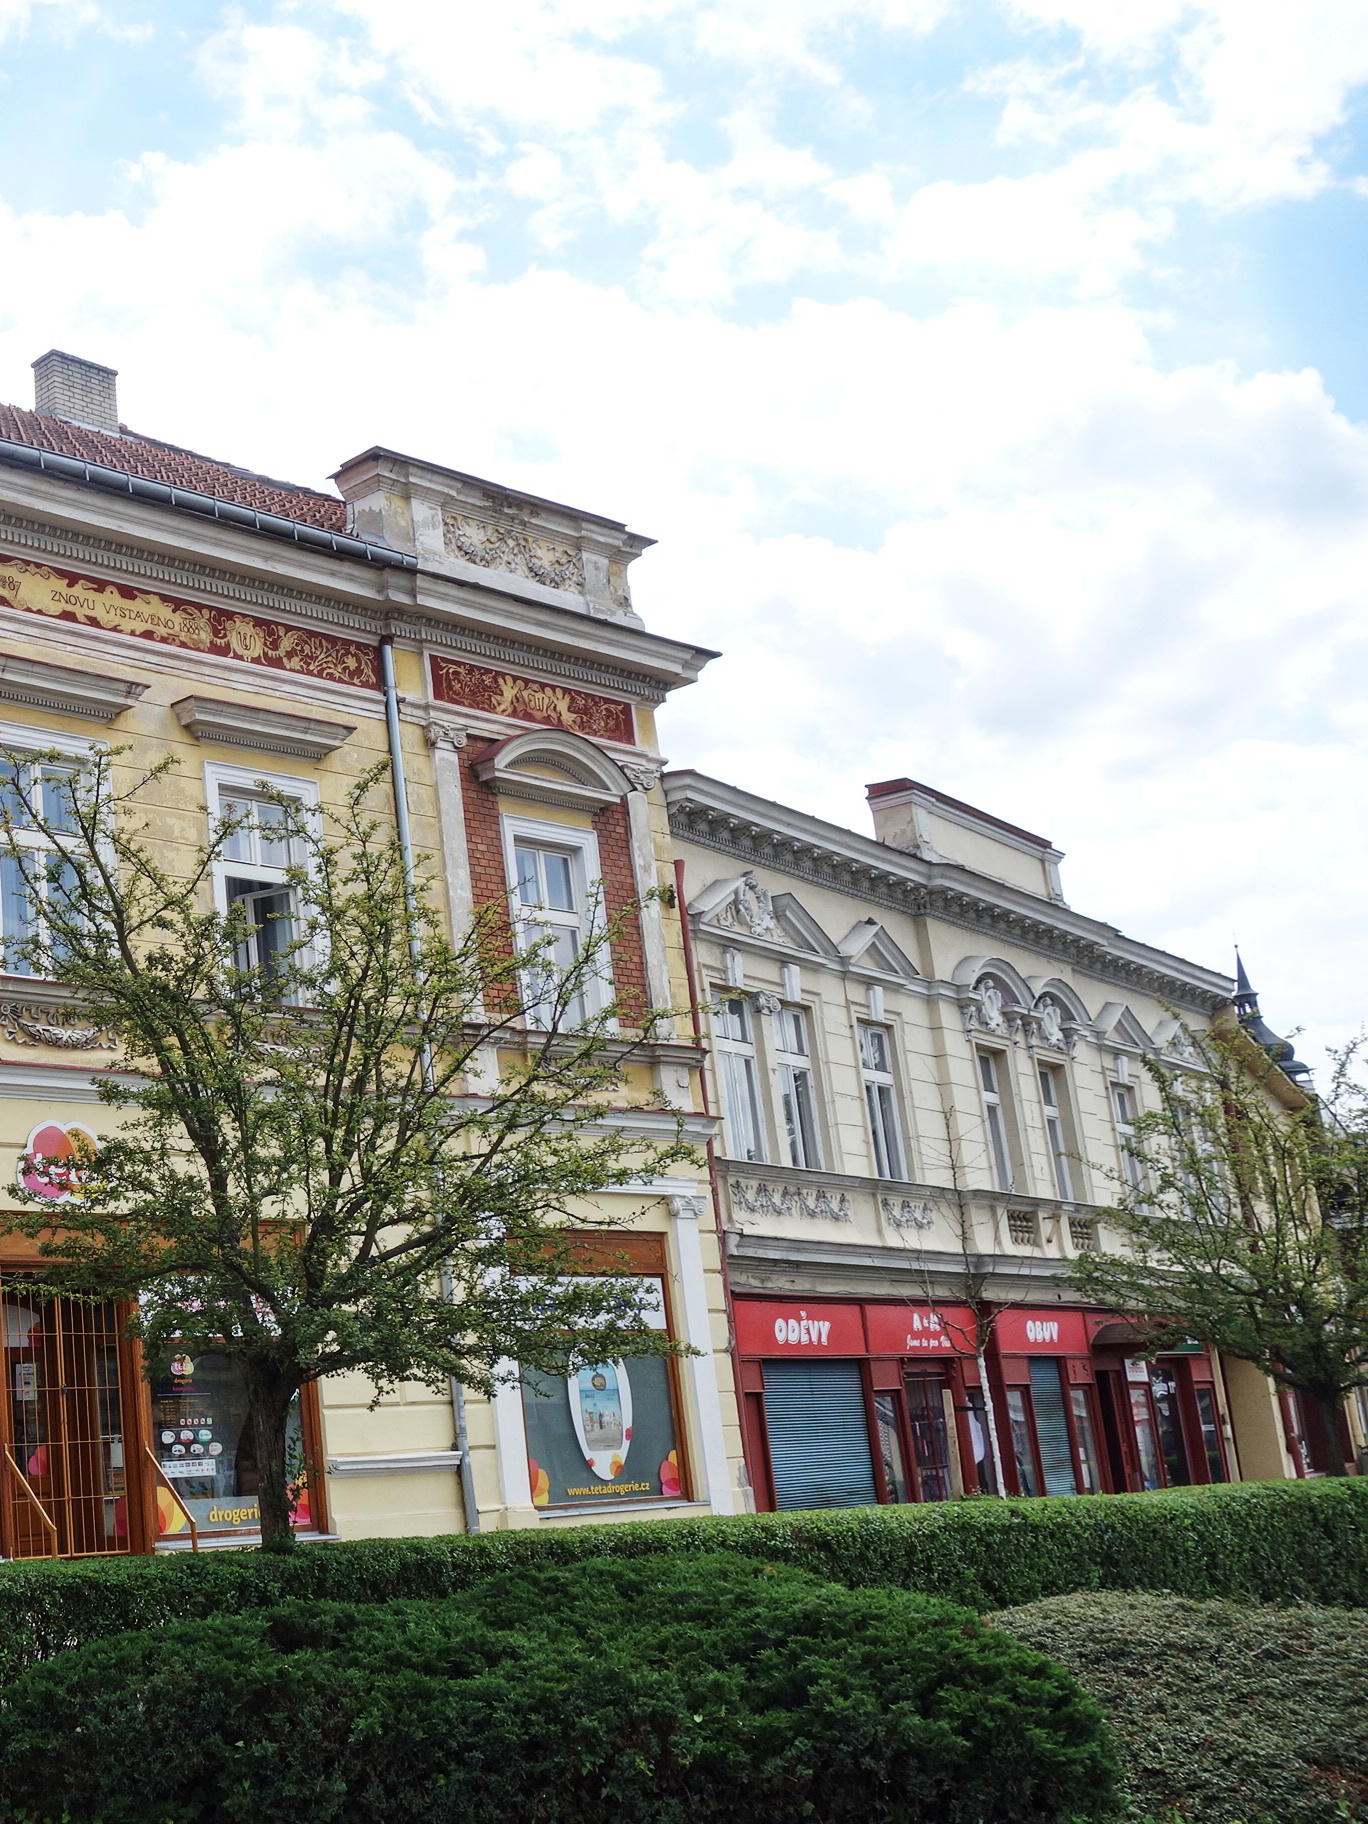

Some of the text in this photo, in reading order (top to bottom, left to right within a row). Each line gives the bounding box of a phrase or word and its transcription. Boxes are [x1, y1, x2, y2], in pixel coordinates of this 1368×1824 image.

[50, 589, 200, 636] ZNOVU VYSTAVENO 1888
[774, 1310, 832, 1346] ODĚVY
[1025, 1319, 1059, 1343] OBUV
[566, 1480, 651, 1496] www.tetadrogerie.cz
